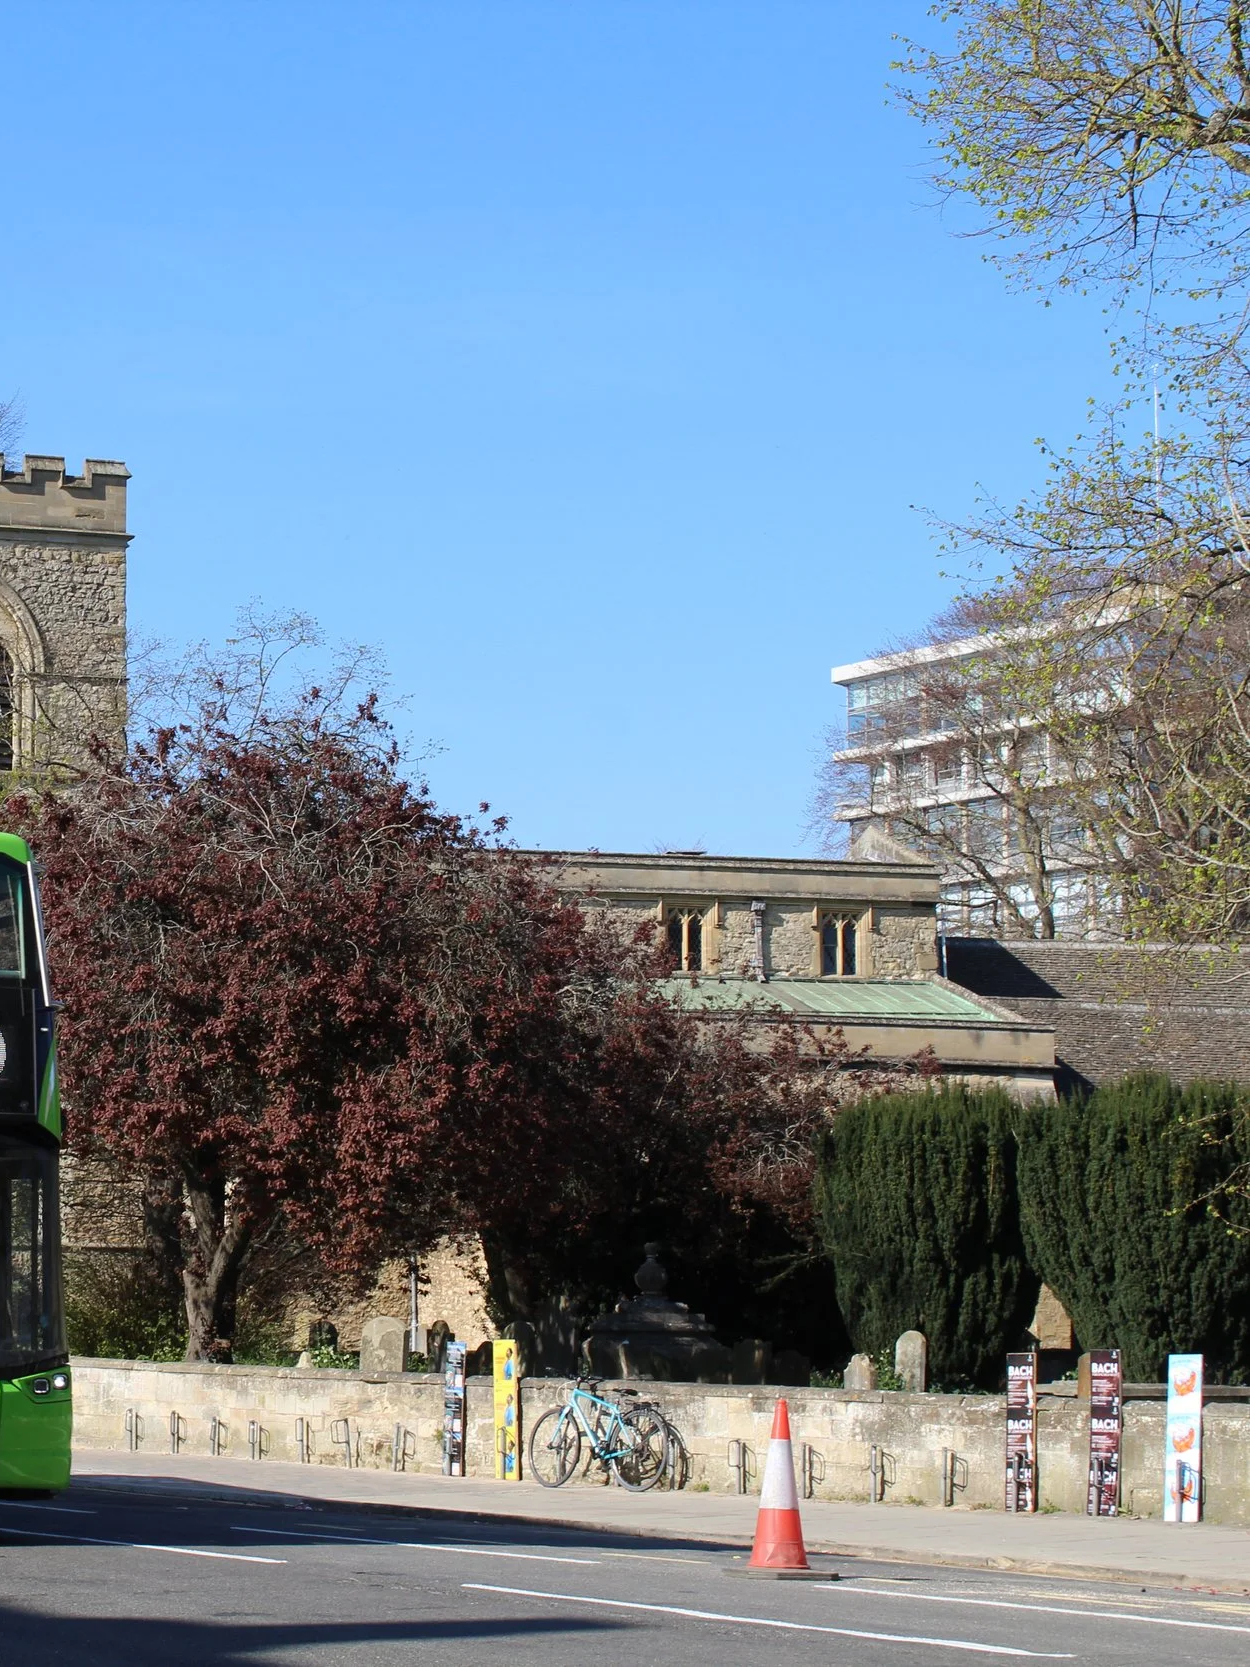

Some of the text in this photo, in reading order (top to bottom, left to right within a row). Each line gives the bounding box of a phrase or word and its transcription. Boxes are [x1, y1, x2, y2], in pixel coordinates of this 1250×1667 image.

[1008, 1365, 1033, 1376] BACH
[1091, 1362, 1118, 1374] BACH
[1007, 1419, 1033, 1430] BACH
[1091, 1418, 1118, 1430] BACH
[1007, 1468, 1032, 1479] BCH
